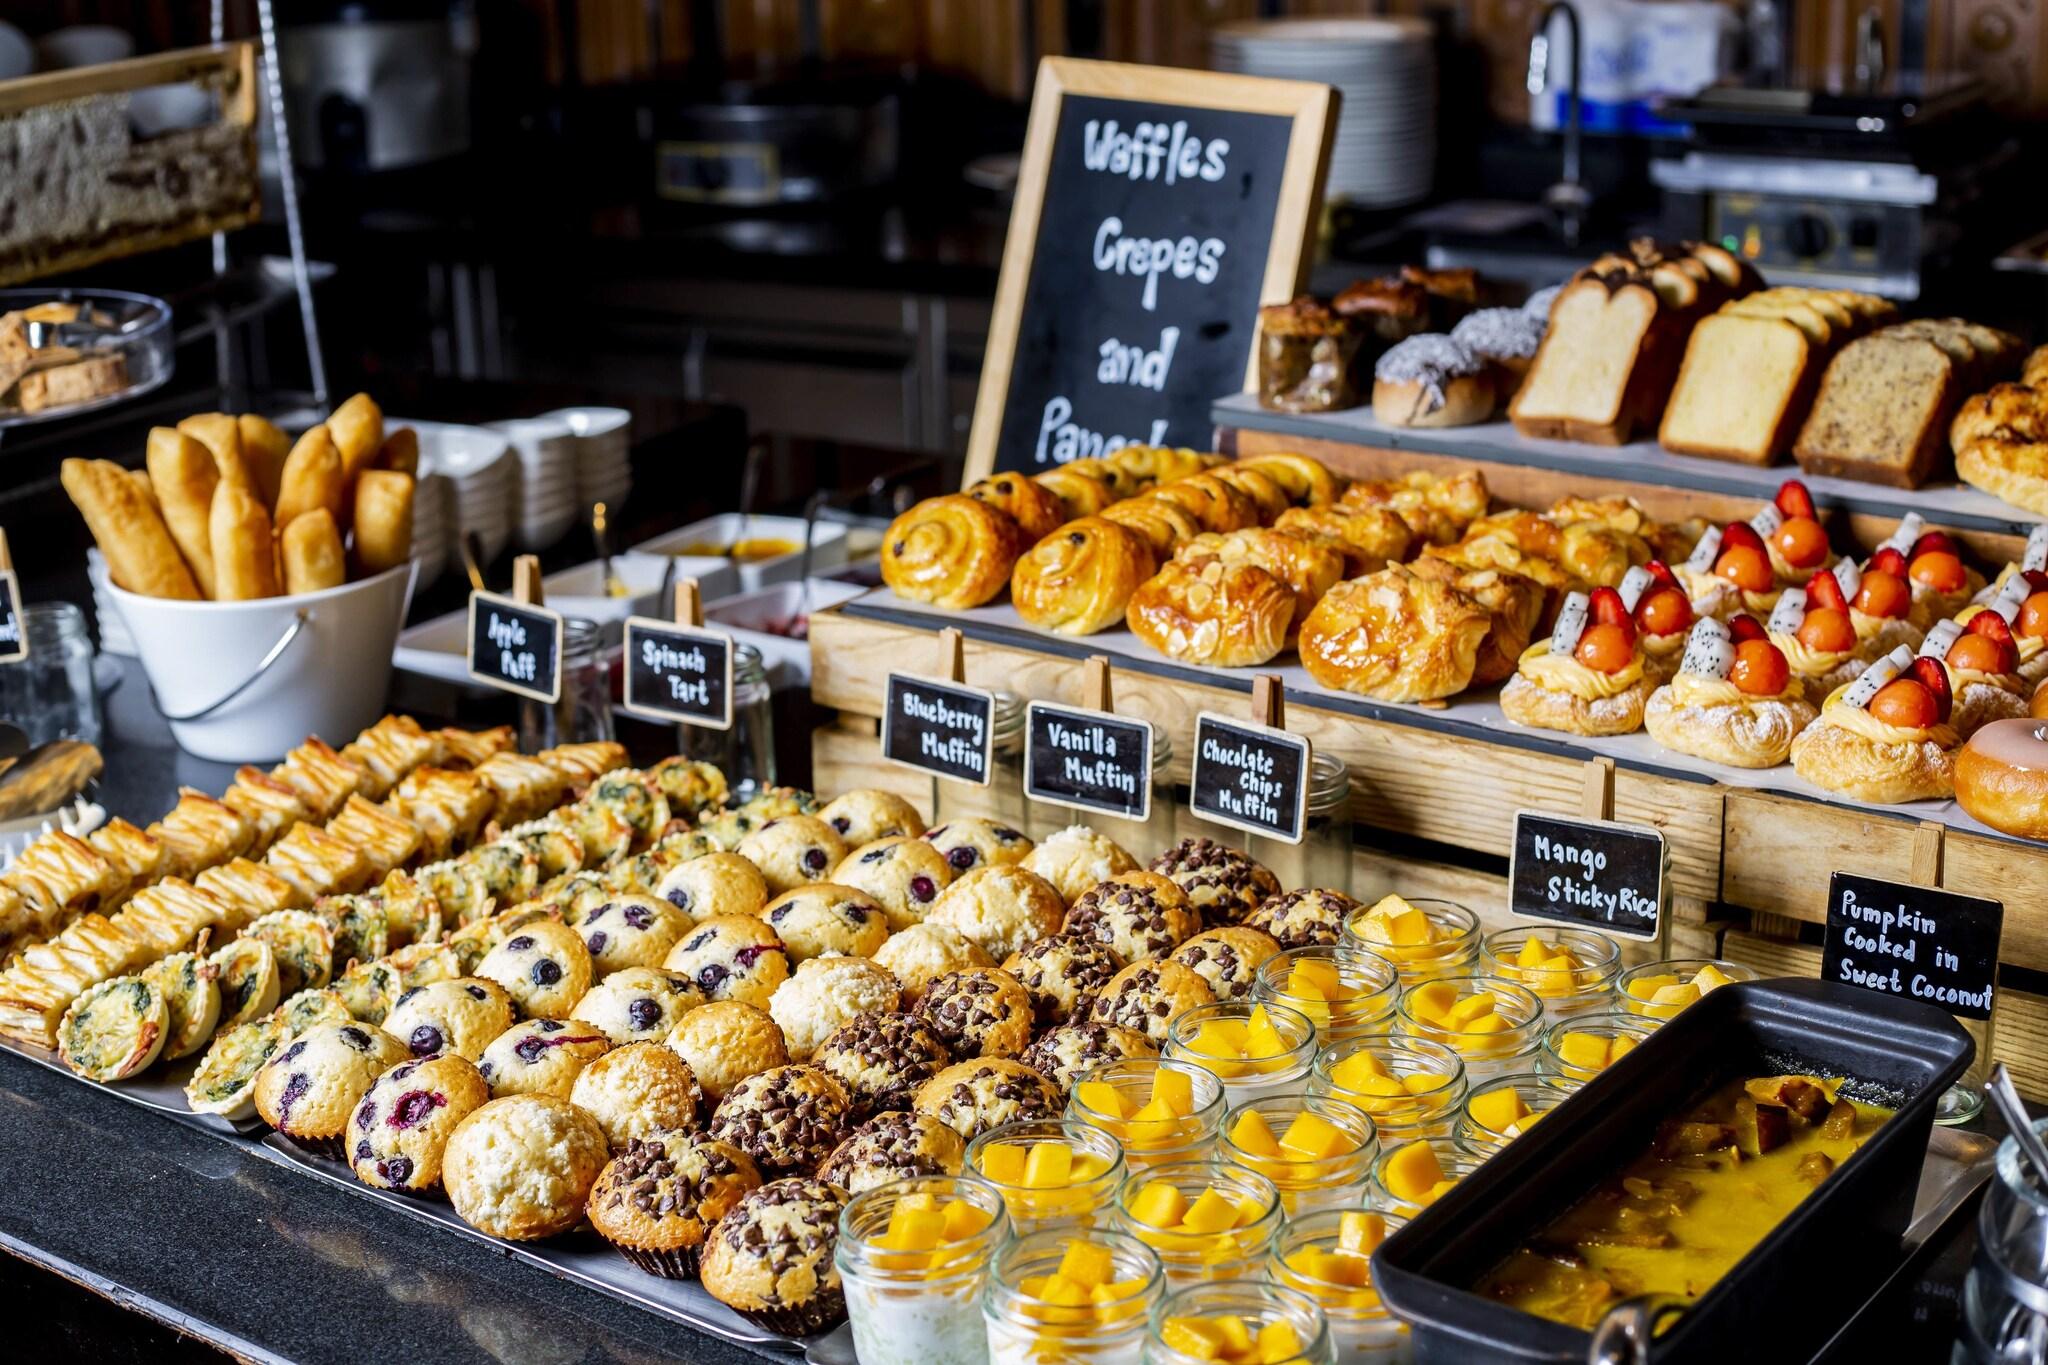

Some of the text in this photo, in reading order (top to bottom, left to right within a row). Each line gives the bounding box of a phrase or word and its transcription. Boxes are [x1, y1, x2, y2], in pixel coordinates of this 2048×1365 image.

[1084, 119, 1231, 186] Waffles
[1093, 215, 1227, 312] Crepes
[1097, 326, 1180, 391] and
[488, 612, 526, 650] Apple
[501, 650, 536, 682] Puff
[642, 639, 706, 675] Spinach
[667, 675, 710, 706] Tart
[903, 692, 984, 746] Blueberry
[921, 732, 983, 773] Muffin
[1047, 722, 1117, 757] Vanilla
[1203, 739, 1274, 775] Chocolate
[1064, 756, 1135, 794] Muffin
[1239, 770, 1283, 803] Chips
[1219, 789, 1278, 824] Muffin
[1534, 835, 1607, 882] Mango
[1841, 889, 1937, 934] Pumpkin
[1844, 927, 1959, 972] Cooked in
[1839, 957, 1993, 1011] Sweet Coconut
